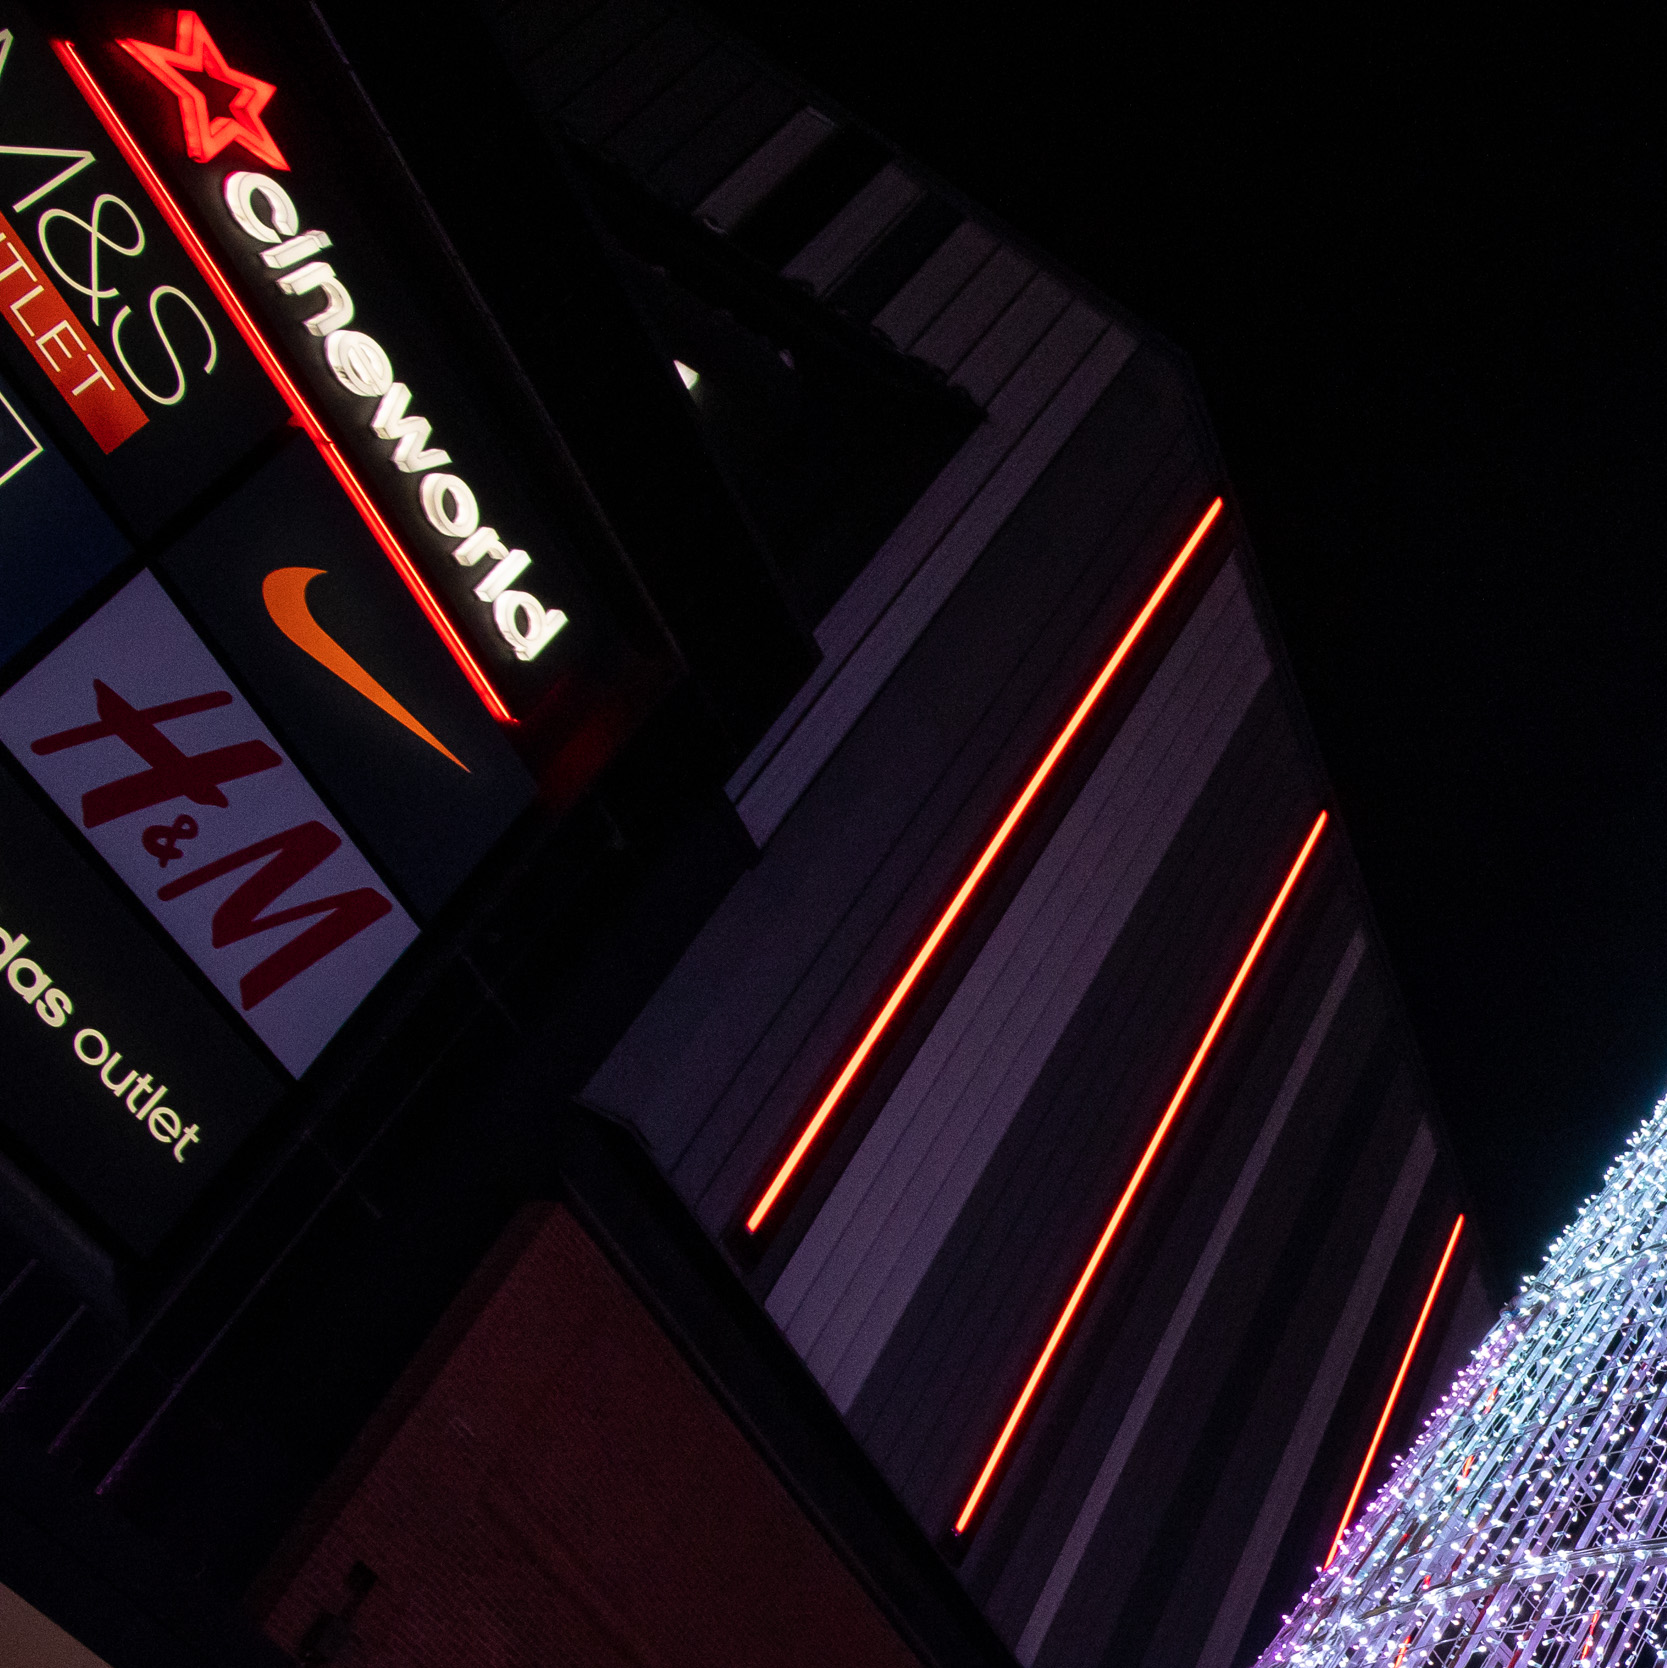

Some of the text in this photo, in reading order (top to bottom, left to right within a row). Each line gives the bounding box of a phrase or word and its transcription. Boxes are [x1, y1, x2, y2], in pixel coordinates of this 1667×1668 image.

[0, 237, 117, 396] TLET
[223, 170, 569, 662] cineworld
[29, 677, 393, 1012] H&M
[0, 926, 201, 1164] das outlet
